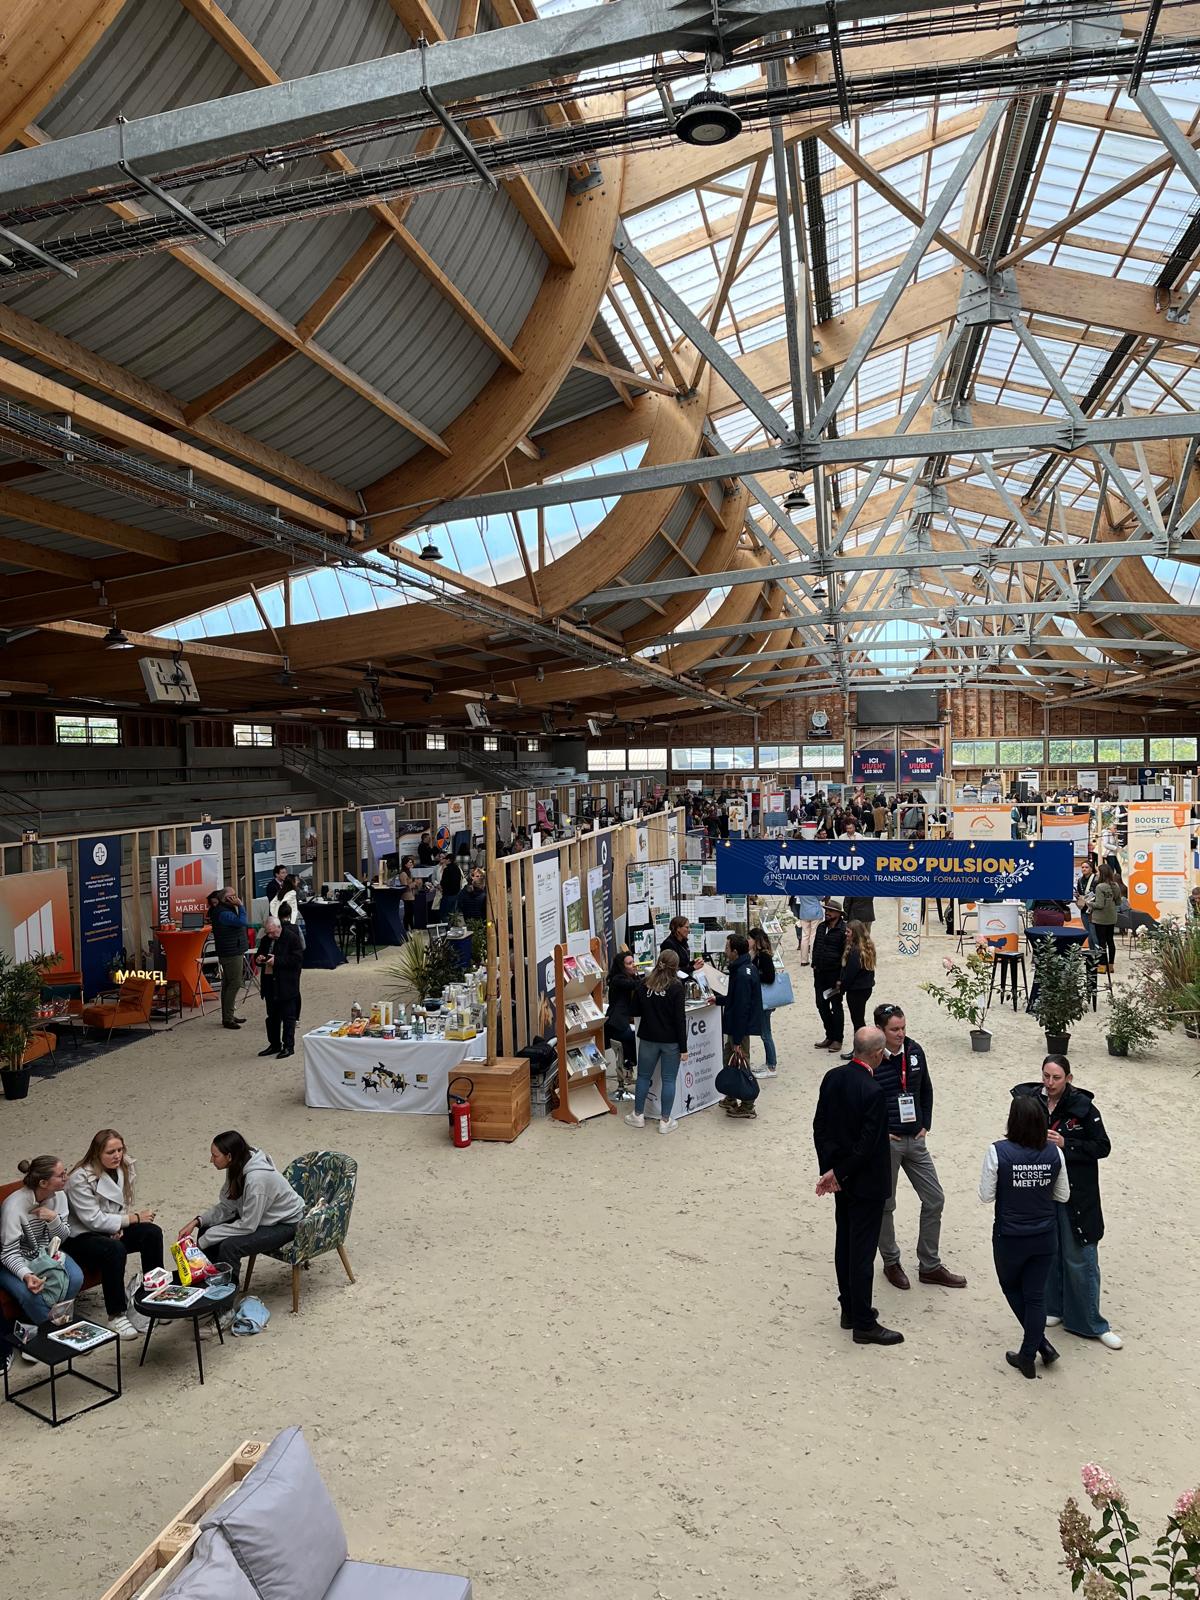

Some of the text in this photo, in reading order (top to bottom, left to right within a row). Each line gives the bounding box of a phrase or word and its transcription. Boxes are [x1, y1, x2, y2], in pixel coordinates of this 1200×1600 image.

[779, 855, 1015, 873] MEET'UP PRO'PULSION
[159, 863, 170, 898] EQUINE
[770, 873, 820, 881] INSTALLATION
[874, 875, 930, 883] TRANSMISSION
[933, 875, 980, 884] FORMATION
[983, 876, 1018, 884] CESSION
[175, 903, 209, 913] MARKEL
[902, 922, 918, 932] 200
[118, 969, 168, 984] MARKEL
[1012, 1179, 1051, 1187] MEET'UP
